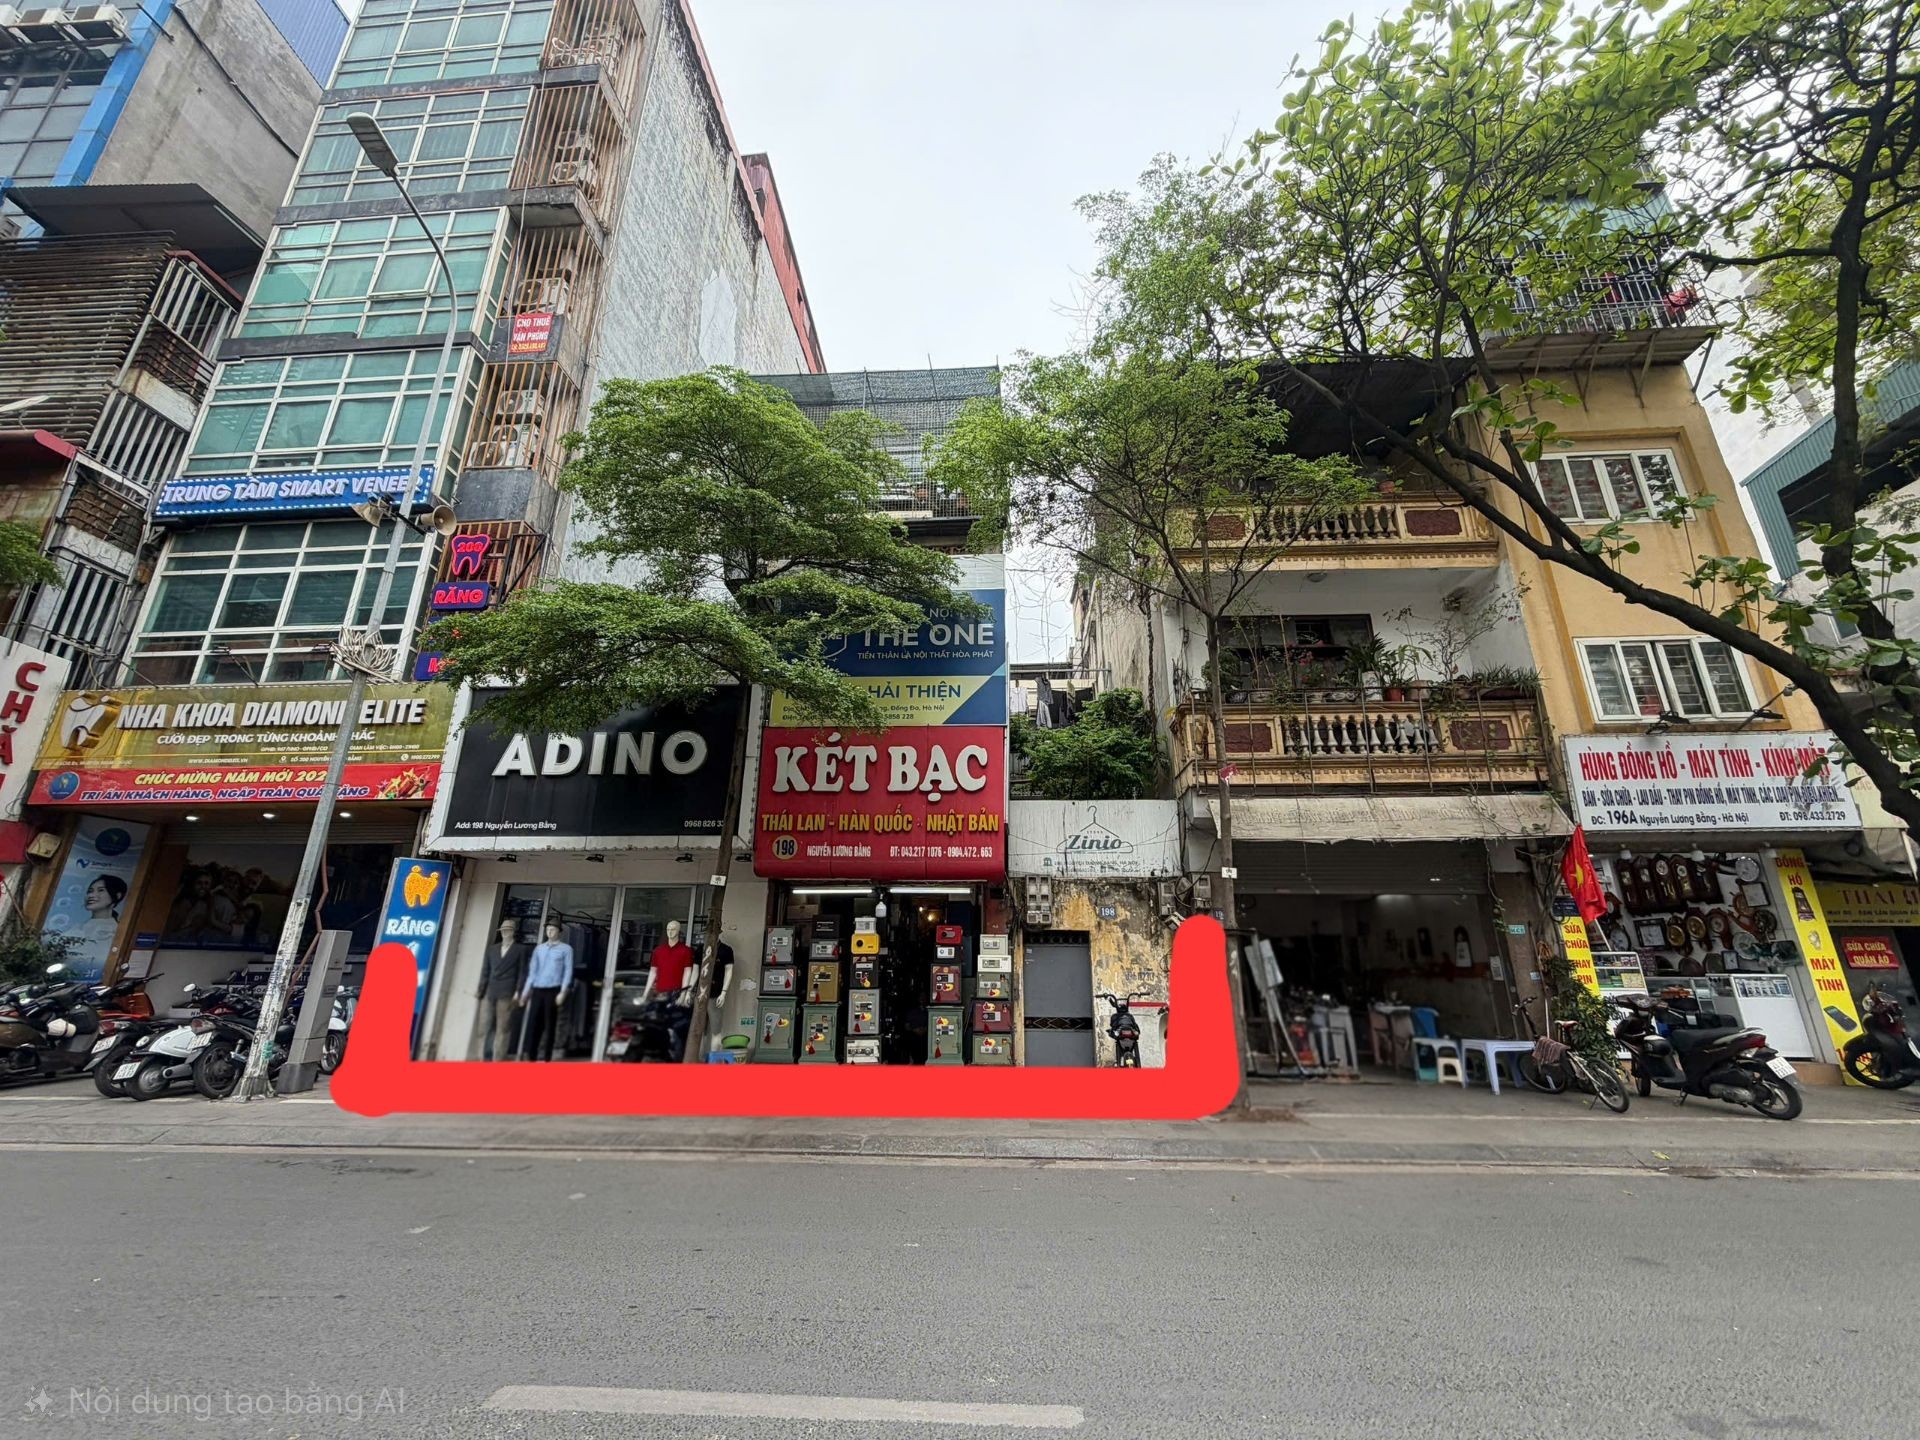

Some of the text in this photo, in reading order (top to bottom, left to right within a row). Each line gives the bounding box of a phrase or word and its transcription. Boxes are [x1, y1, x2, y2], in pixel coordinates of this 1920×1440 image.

[164, 485, 232, 502] TRUNG
[234, 477, 278, 499] TÂM
[279, 478, 350, 498] SMART
[433, 585, 484, 604] RĂNG
[864, 623, 995, 647] THE ONE
[905, 680, 962, 702] THIỆN
[116, 704, 167, 729] NHA
[171, 702, 236, 728] KHOA
[358, 699, 427, 725] ELITE
[187, 733, 211, 746] ĐẸP
[214, 733, 254, 744] TRONG
[257, 731, 289, 743] TỪNG
[351, 727, 377, 741] HẮC
[490, 730, 708, 777] ADINO
[1578, 746, 1618, 781] HÙNG
[1618, 741, 1658, 780] ĐỒNG
[1656, 740, 1678, 779] HỒ
[1686, 743, 1719, 778] MÁY
[1718, 743, 1754, 777] TÍNH
[1761, 742, 1799, 777] KÍNH
[135, 770, 176, 785] CHÚC
[175, 770, 223, 784] MỪNG
[224, 769, 258, 783] NĂM
[260, 767, 293, 782] MỚI
[887, 744, 988, 802] BẠC
[79, 790, 103, 801] TRI
[124, 787, 173, 800] KHÁCH
[172, 787, 214, 800] HÀNG,
[217, 786, 256, 801] NGẬP
[337, 783, 371, 798] ẶNG
[1582, 786, 1597, 807] BÁN
[472, 821, 484, 829] 198
[762, 810, 793, 832] THÁI
[797, 814, 826, 832] LAN
[839, 810, 870, 832] HÀN
[874, 803, 913, 833] QUỐC
[926, 808, 964, 836] NHẬT
[969, 807, 999, 832] BẢN
[1591, 816, 1606, 825] ĐC:
[1606, 809, 1639, 825] 196A
[1670, 814, 1695, 826] Lương
[1721, 813, 1734, 823] Hà
[1736, 812, 1749, 825] Nội
[1779, 811, 1793, 821] ĐT:
[774, 838, 795, 856] 198
[1066, 834, 1122, 850] Zinio
[1101, 907, 1116, 917] 198
[385, 915, 437, 936] RĂNG
[1563, 921, 1582, 935] SỬA
[1564, 937, 1589, 950] CHỮA
[1809, 955, 1837, 971] MÁY
[1815, 975, 1845, 991] TÍNH
